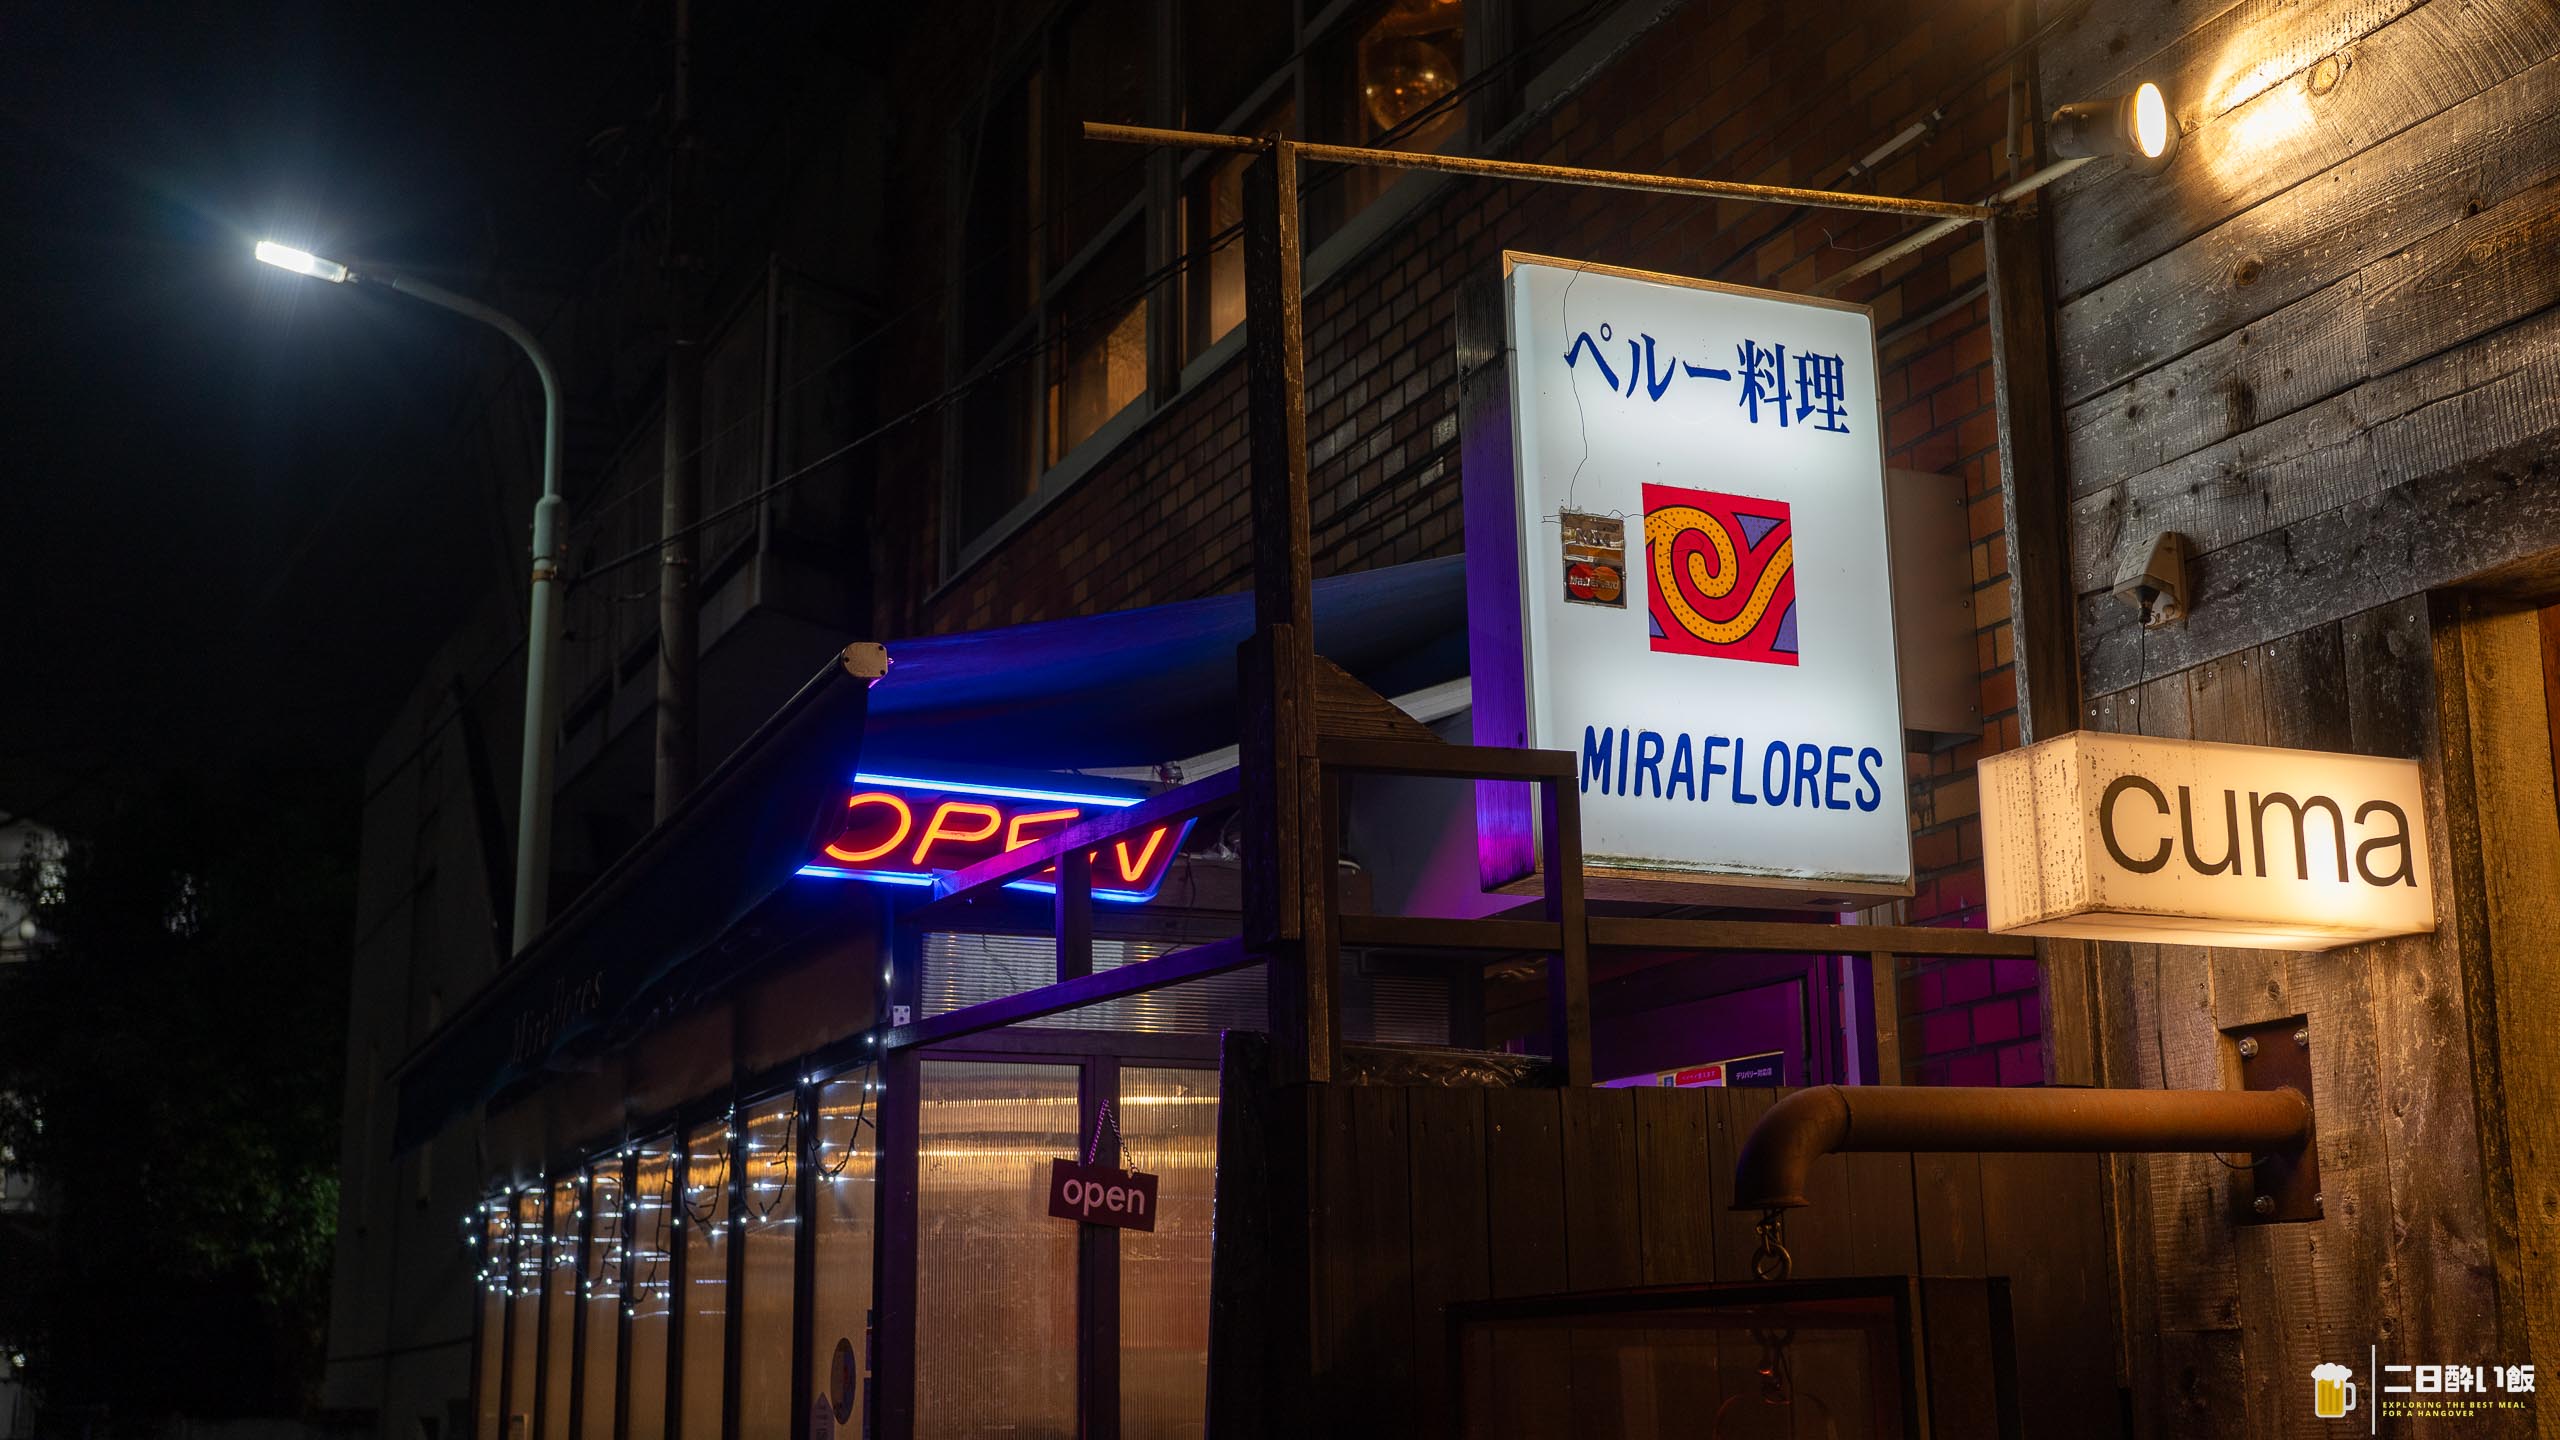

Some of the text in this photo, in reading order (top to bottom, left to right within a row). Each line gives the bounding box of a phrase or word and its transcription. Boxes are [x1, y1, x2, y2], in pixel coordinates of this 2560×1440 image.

[1563, 322, 1851, 434] ペルー料理
[1581, 725, 1884, 812] MIRAFLORES
[2100, 775, 2417, 887] cuma
[1063, 1179, 1145, 1217] open
